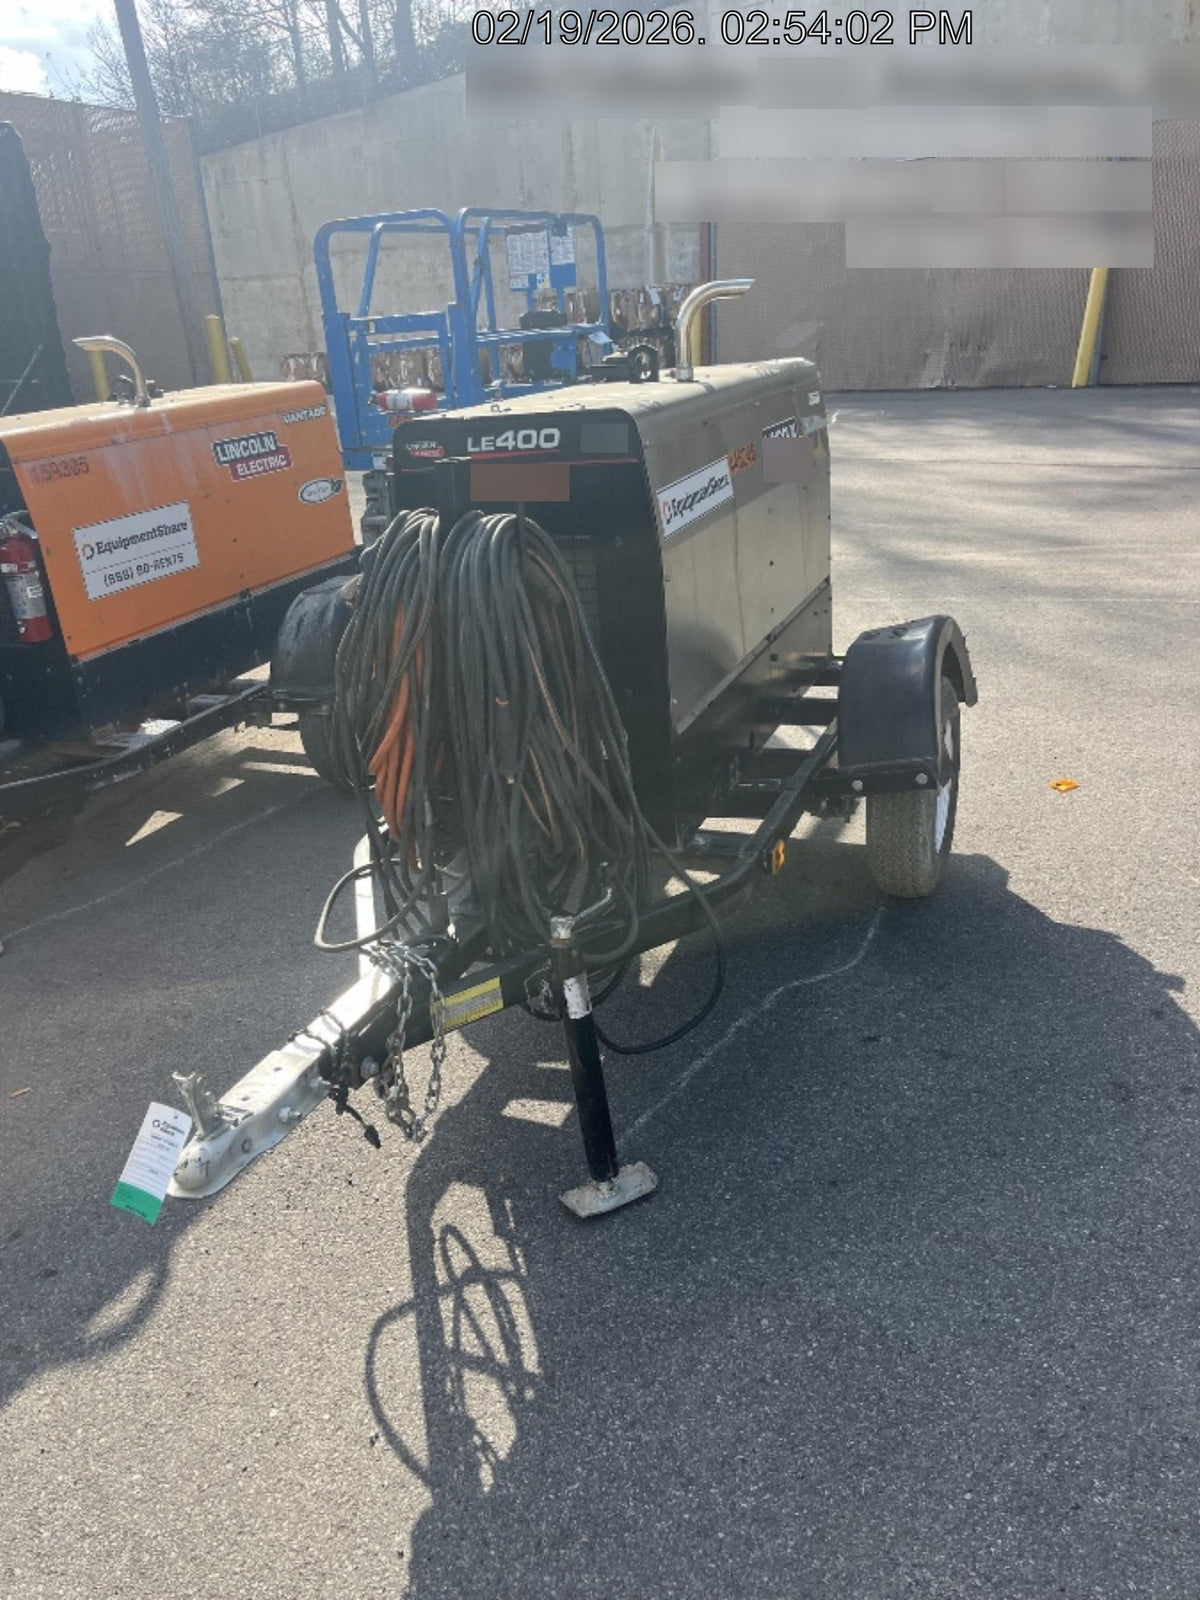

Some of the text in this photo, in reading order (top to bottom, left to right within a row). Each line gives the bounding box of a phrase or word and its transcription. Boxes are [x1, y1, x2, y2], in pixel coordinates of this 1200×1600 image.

[215, 434, 277, 462] LINCOLN
[467, 427, 561, 452] LE400
[236, 454, 288, 476] ELECTRIC
[95, 521, 188, 556] EquipmentShare
